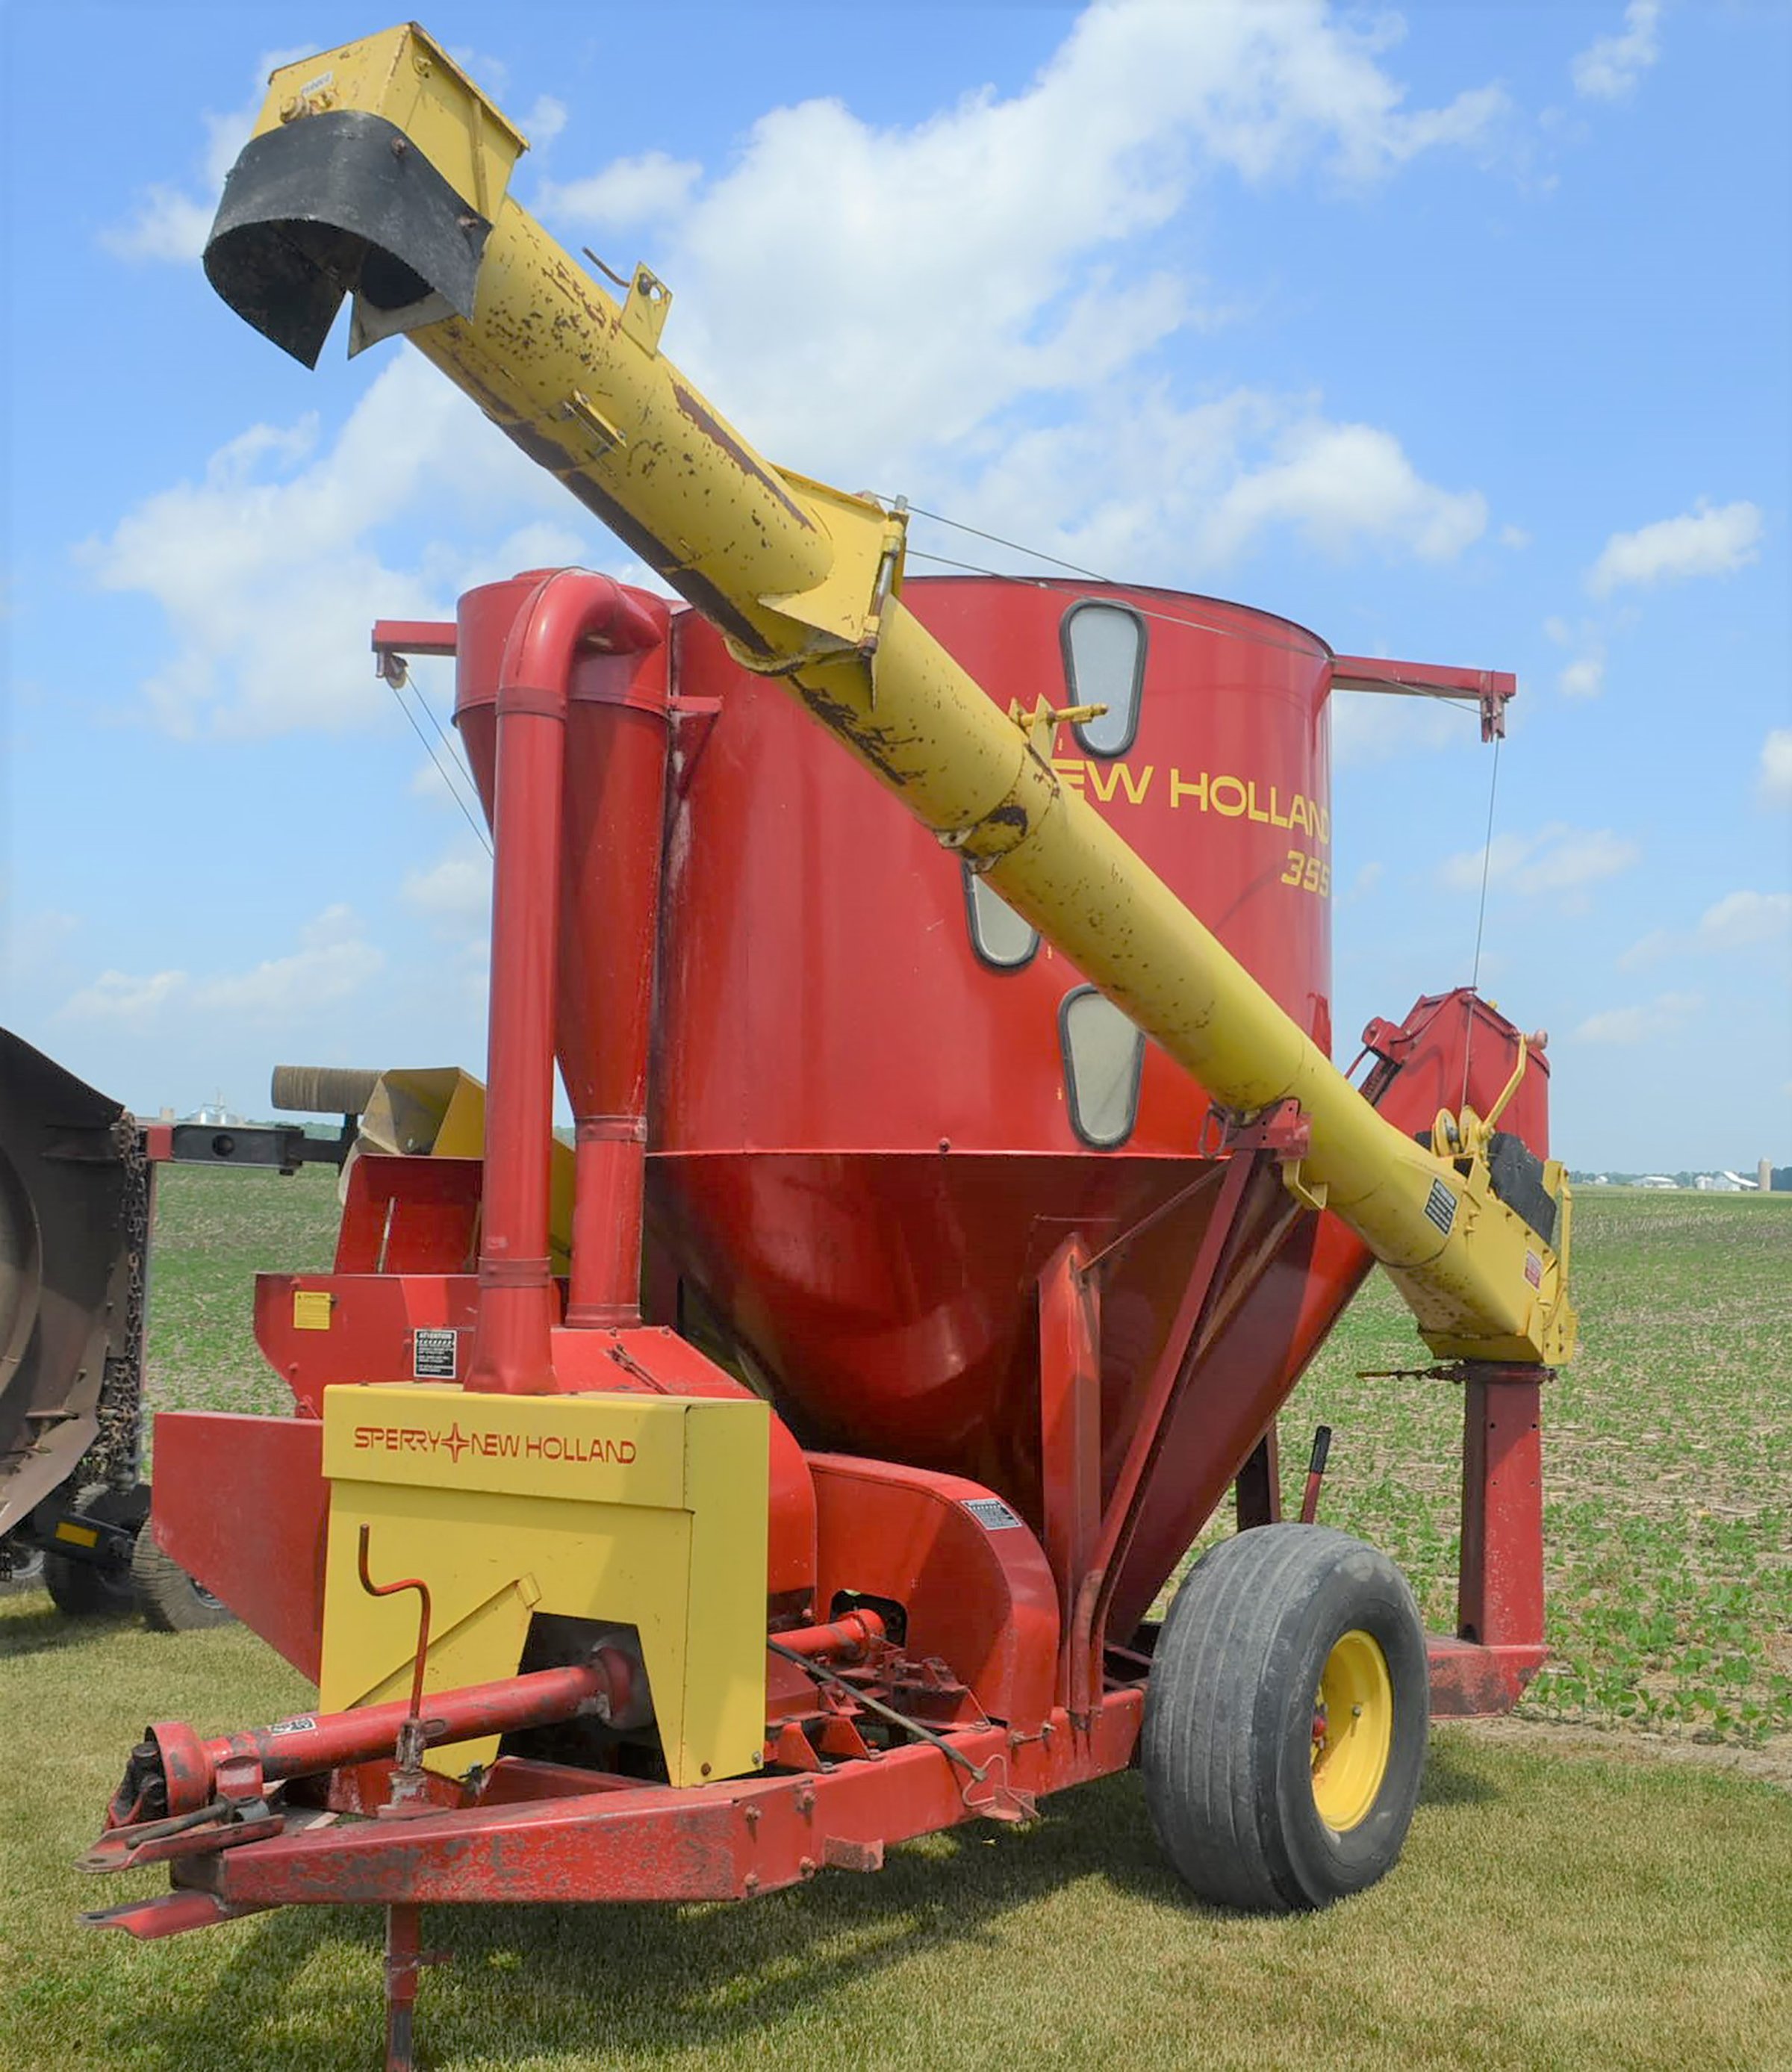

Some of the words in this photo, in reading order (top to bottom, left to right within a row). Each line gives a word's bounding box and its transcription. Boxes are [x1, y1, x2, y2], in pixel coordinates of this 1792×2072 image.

[1051, 758, 1154, 805] EW
[354, 1427, 441, 1453] SPERRY
[471, 1433, 520, 1457] NEW
[525, 1435, 637, 1464] HOLLAND
